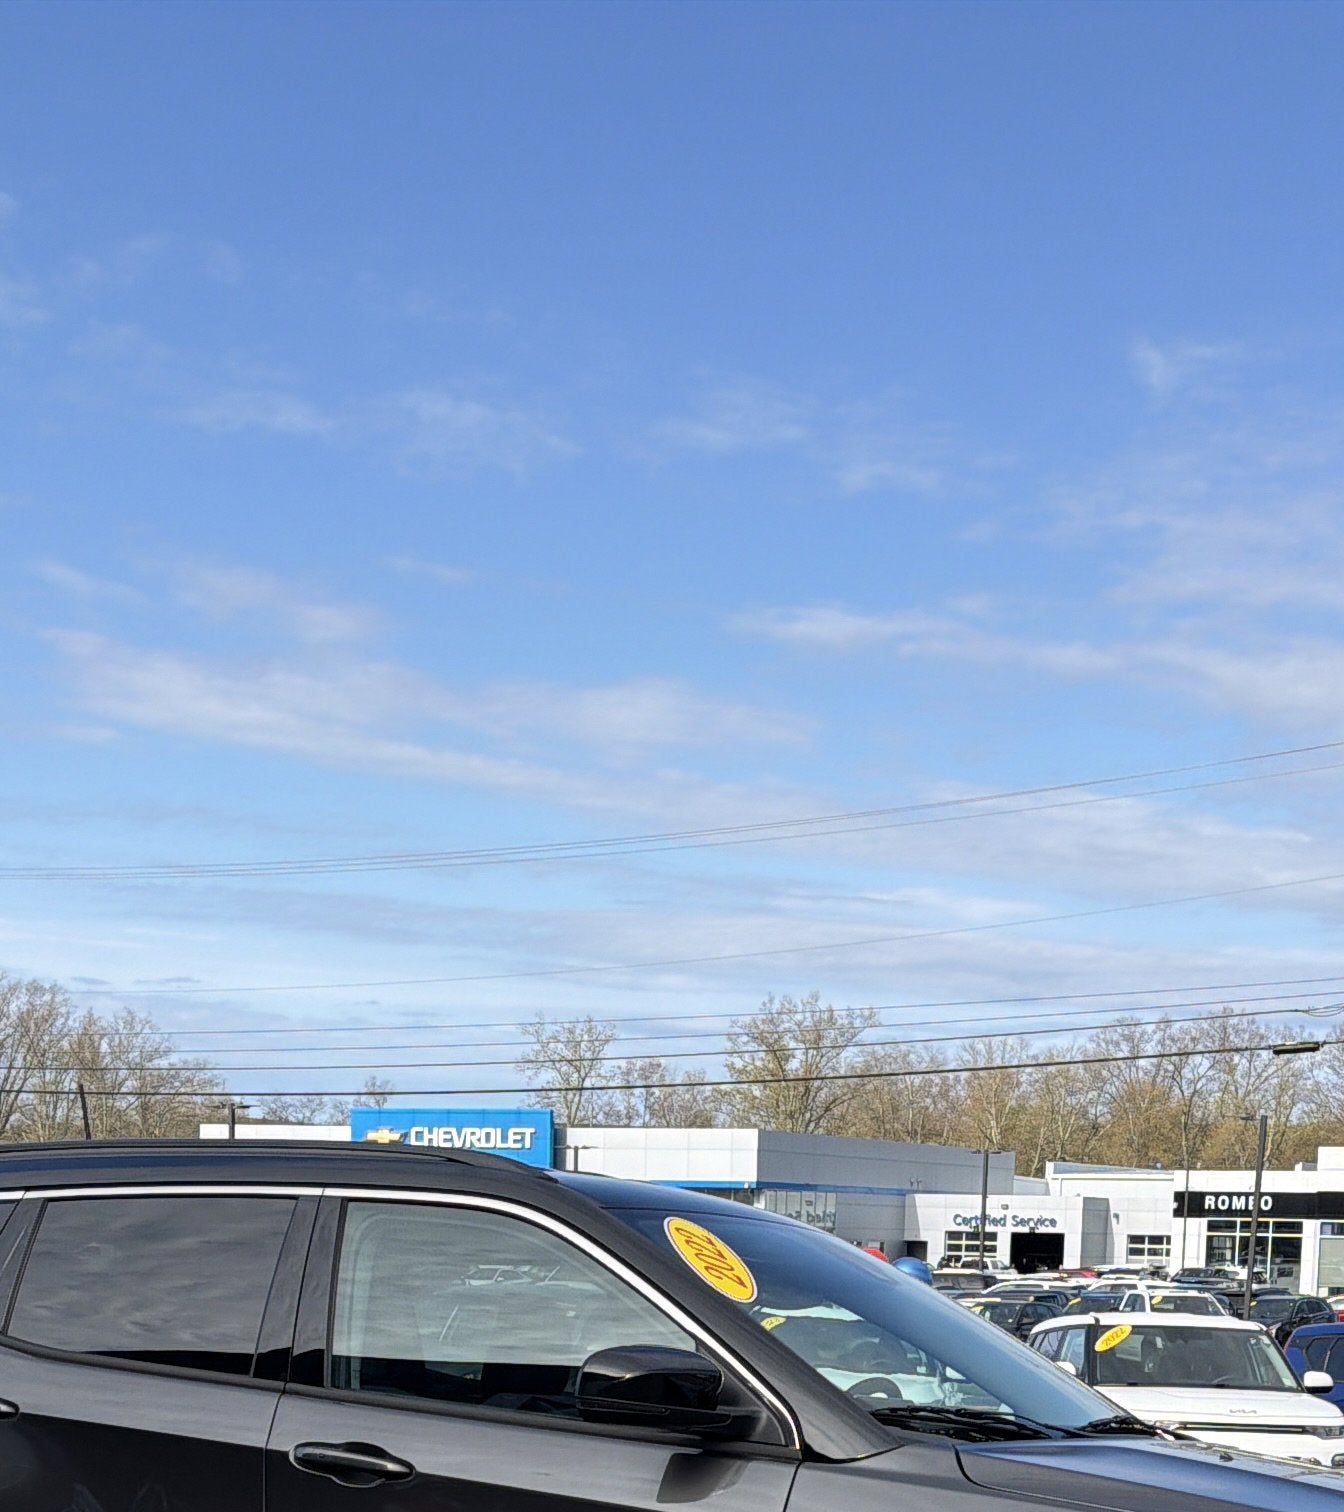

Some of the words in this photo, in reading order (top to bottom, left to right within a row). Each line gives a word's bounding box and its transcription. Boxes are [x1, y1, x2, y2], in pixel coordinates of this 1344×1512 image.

[410, 1126, 536, 1149] CHEVROLET
[1204, 1195, 1273, 1211] ROMEO
[1011, 1214, 1057, 1229] Service
[674, 1227, 748, 1289] 2022
